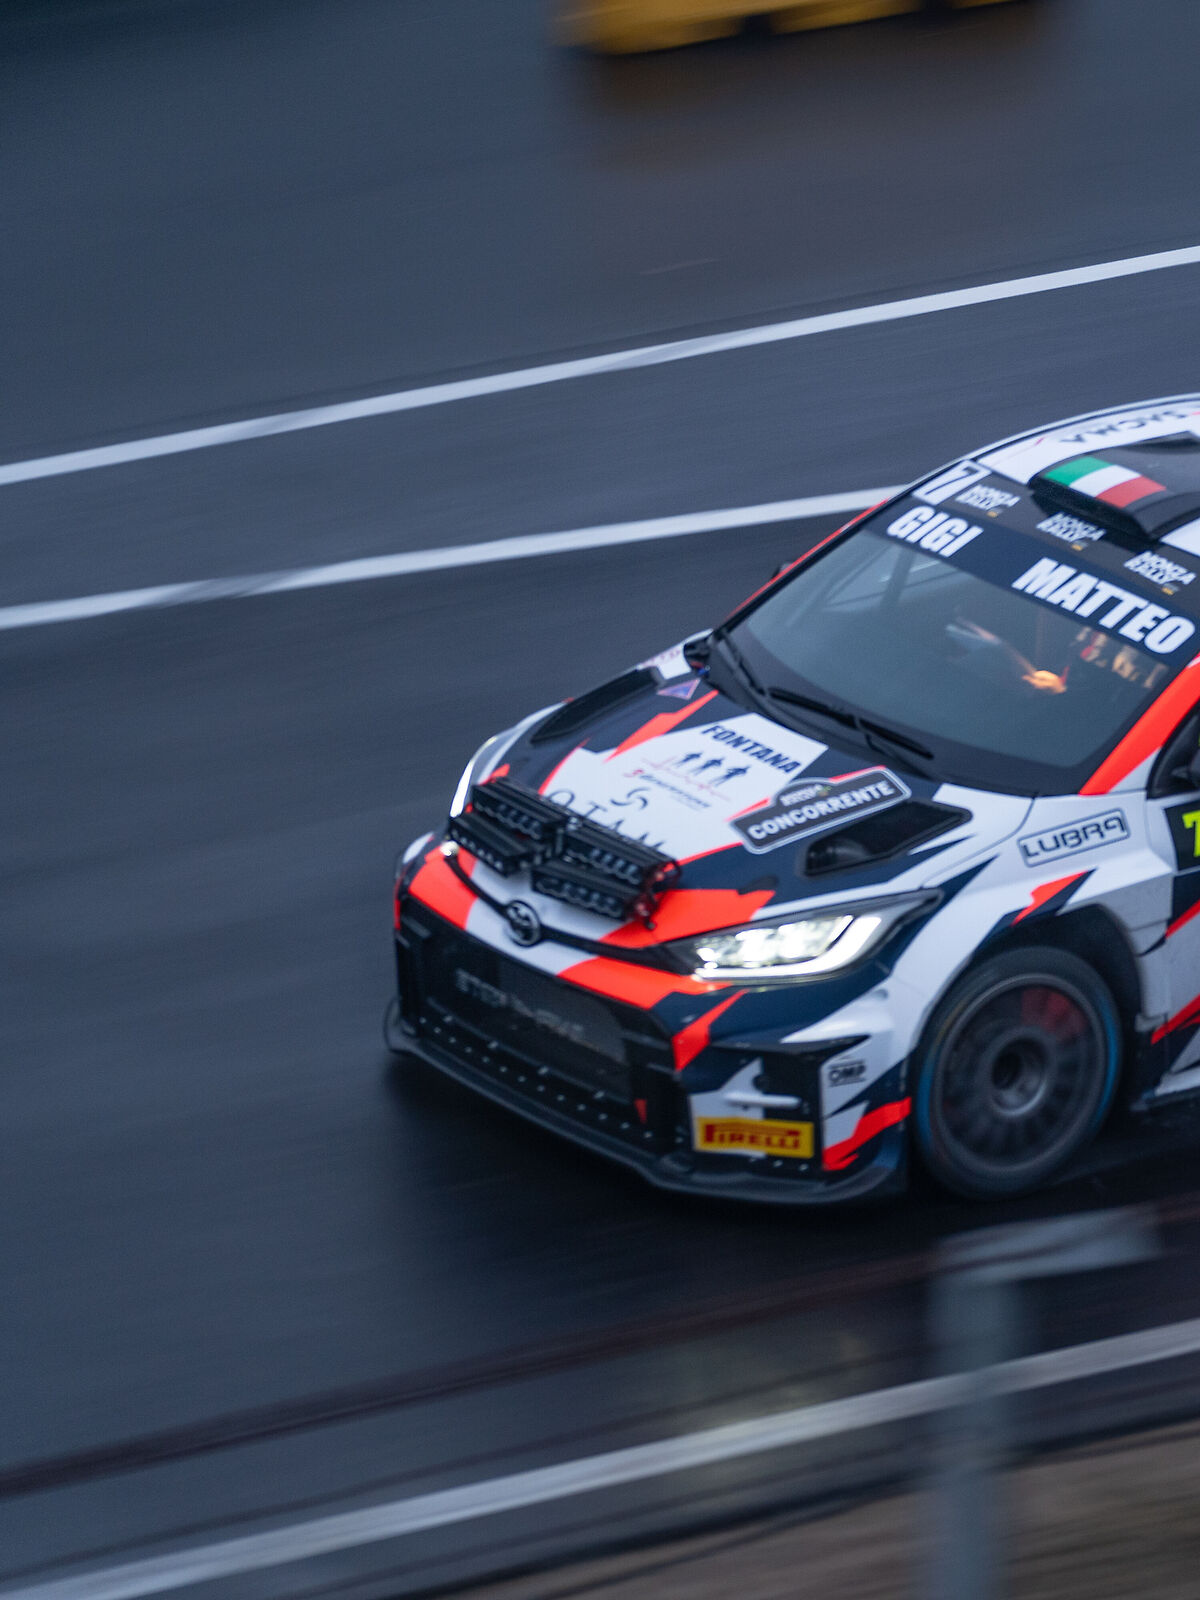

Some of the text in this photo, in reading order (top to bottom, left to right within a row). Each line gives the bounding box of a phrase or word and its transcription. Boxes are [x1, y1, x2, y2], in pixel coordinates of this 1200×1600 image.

[886, 505, 984, 557] GIGI
[1138, 551, 1197, 585] MONZA
[1011, 556, 1196, 655] MATTEO
[700, 722, 801, 775] FONTANA
[747, 780, 896, 840] CONCORRENTE
[704, 1123, 801, 1150] PIRELLI
